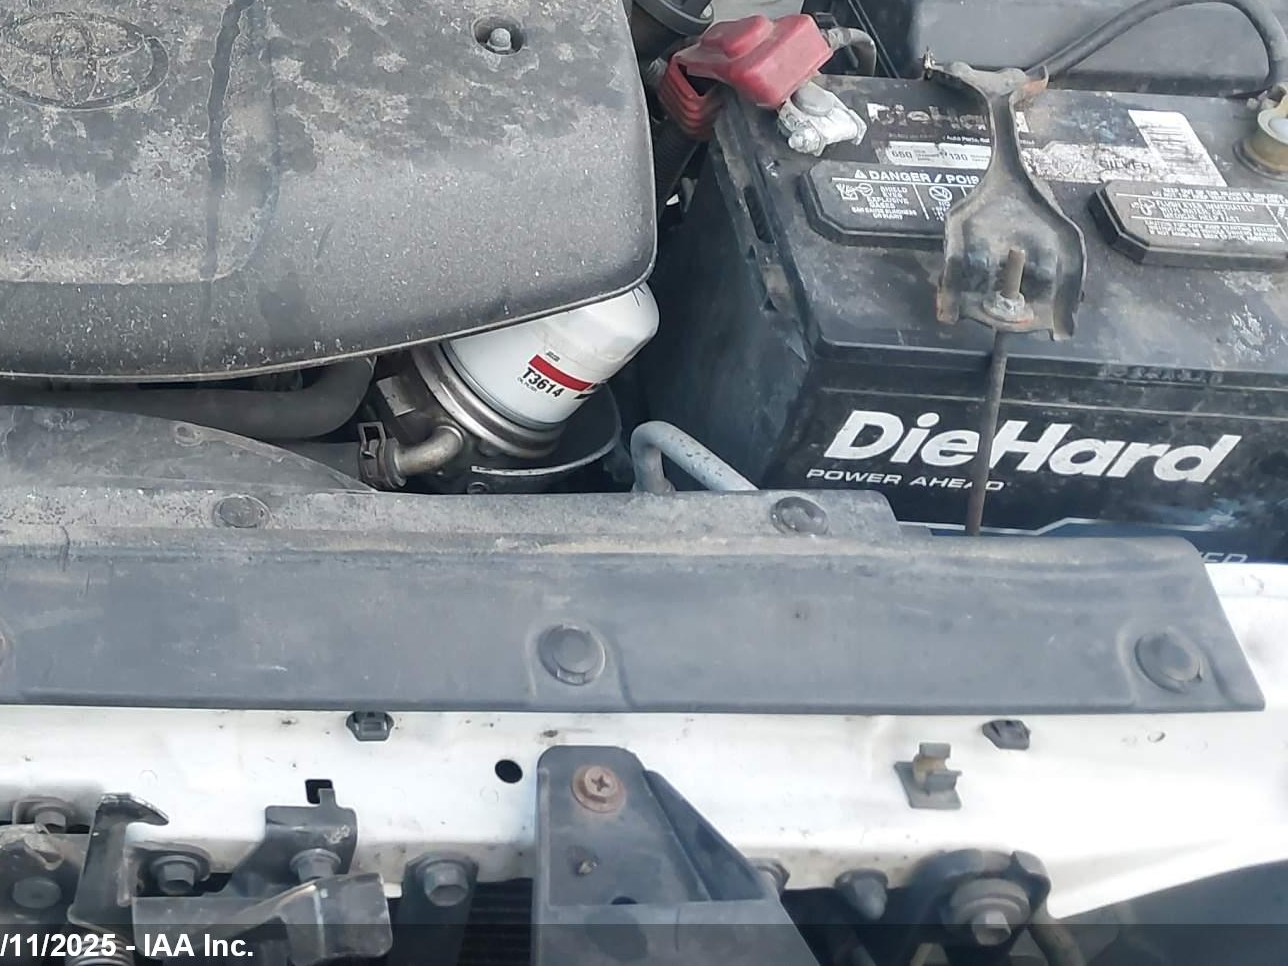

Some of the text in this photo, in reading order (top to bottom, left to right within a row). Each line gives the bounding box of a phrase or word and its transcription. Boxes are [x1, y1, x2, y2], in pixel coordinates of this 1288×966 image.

[949, 153, 968, 161] 130
[1101, 158, 1151, 172] SILVER
[868, 170, 931, 183] DANGER
[945, 175, 979, 185] POIS
[521, 367, 564, 398] T3614
[824, 409, 1242, 484] DieHard
[806, 469, 902, 485] POWER
